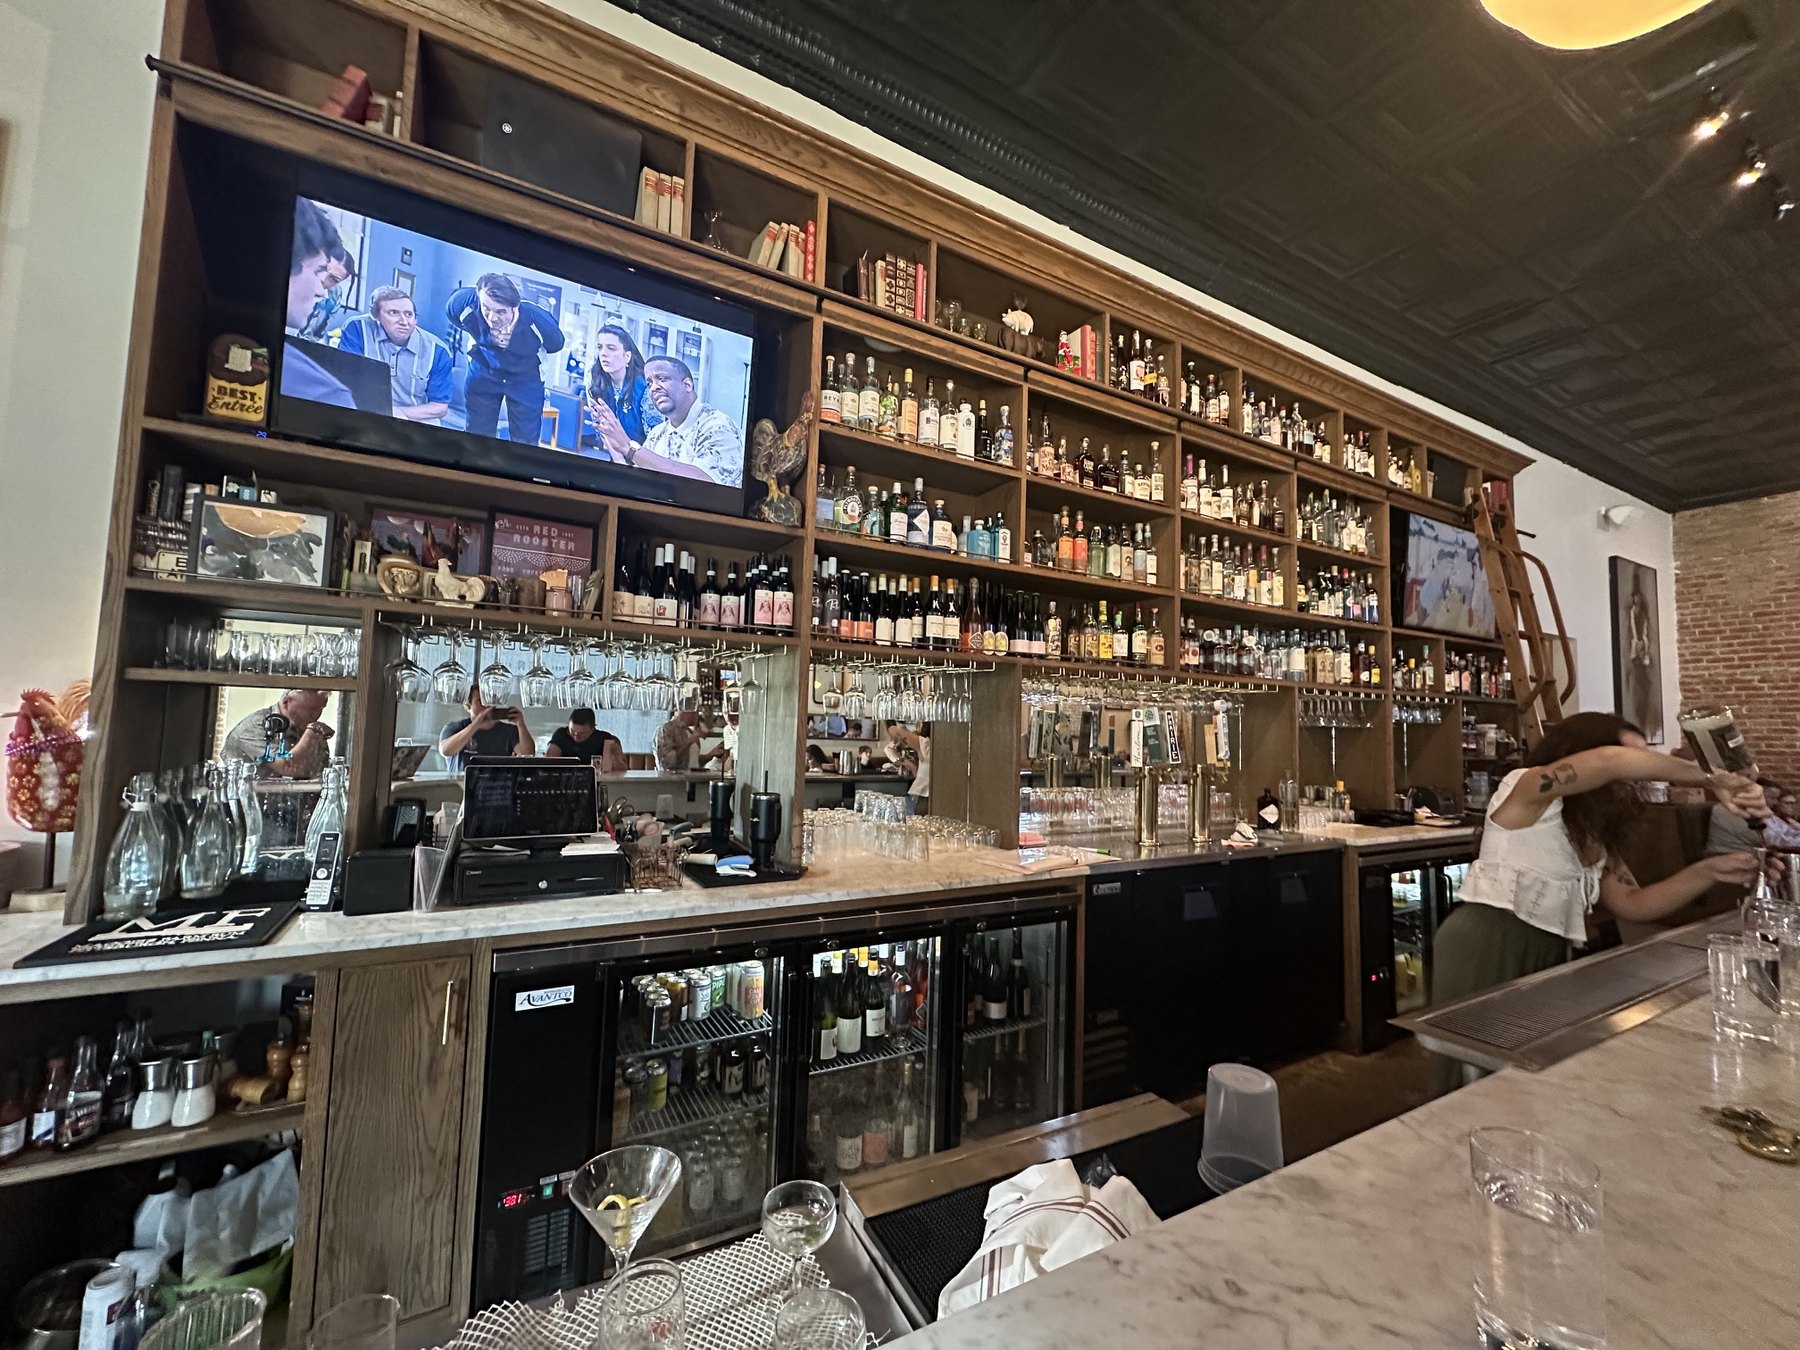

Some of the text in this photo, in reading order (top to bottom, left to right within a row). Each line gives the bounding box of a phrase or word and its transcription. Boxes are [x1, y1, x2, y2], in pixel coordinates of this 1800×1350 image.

[216, 385, 257, 402] BEST
[533, 525, 559, 537] RED
[512, 534, 575, 551] ROOSTER
[1167, 713, 1178, 759] PRAIRIE
[519, 991, 573, 1006] AVANTCO
